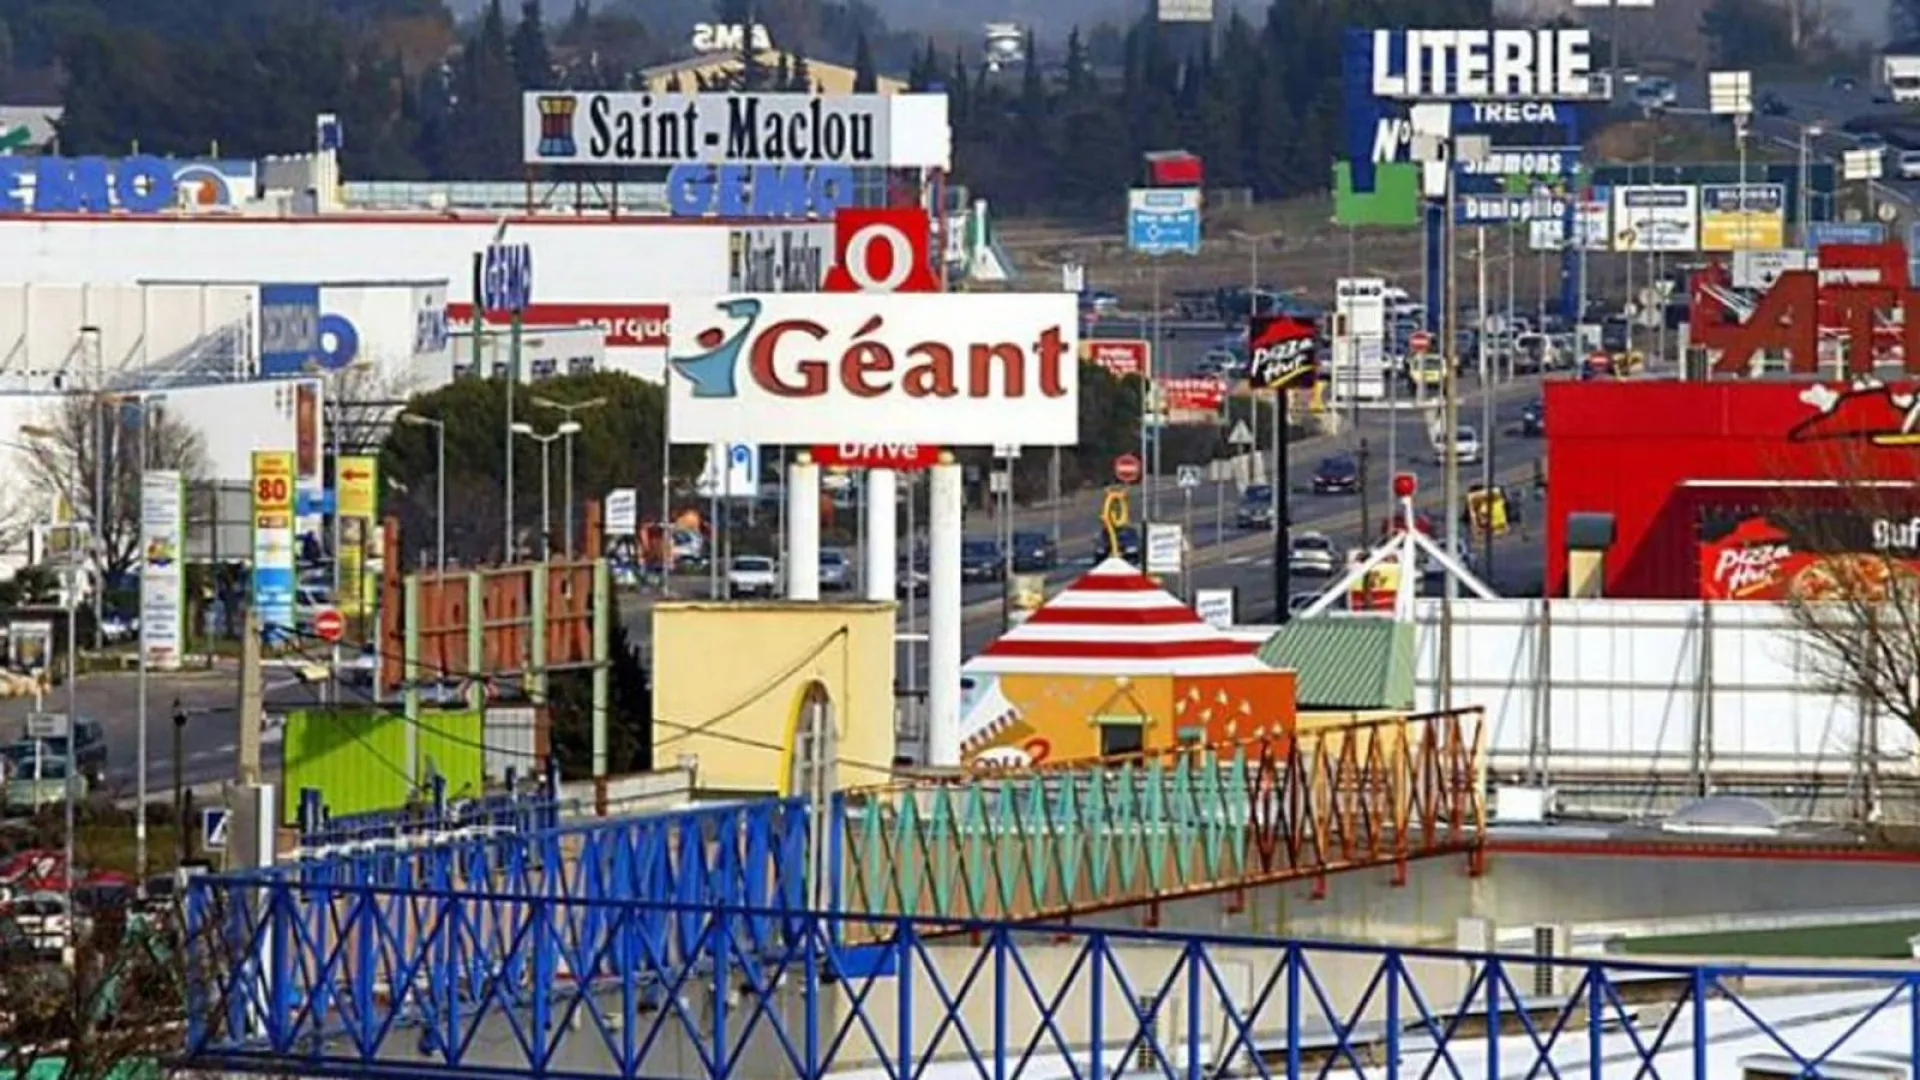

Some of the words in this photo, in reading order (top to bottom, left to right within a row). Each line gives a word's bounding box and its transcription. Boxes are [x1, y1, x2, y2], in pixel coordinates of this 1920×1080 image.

[1373, 29, 1591, 96] LITERIE
[589, 95, 873, 161] Saint-Maclou
[1470, 103, 1556, 122] TRECA
[748, 314, 1070, 399] Géant
[1251, 338, 1314, 377] Pizza
[1263, 353, 1308, 384] Hut
[258, 477, 287, 501] 80
[1714, 544, 1793, 582] Pizza
